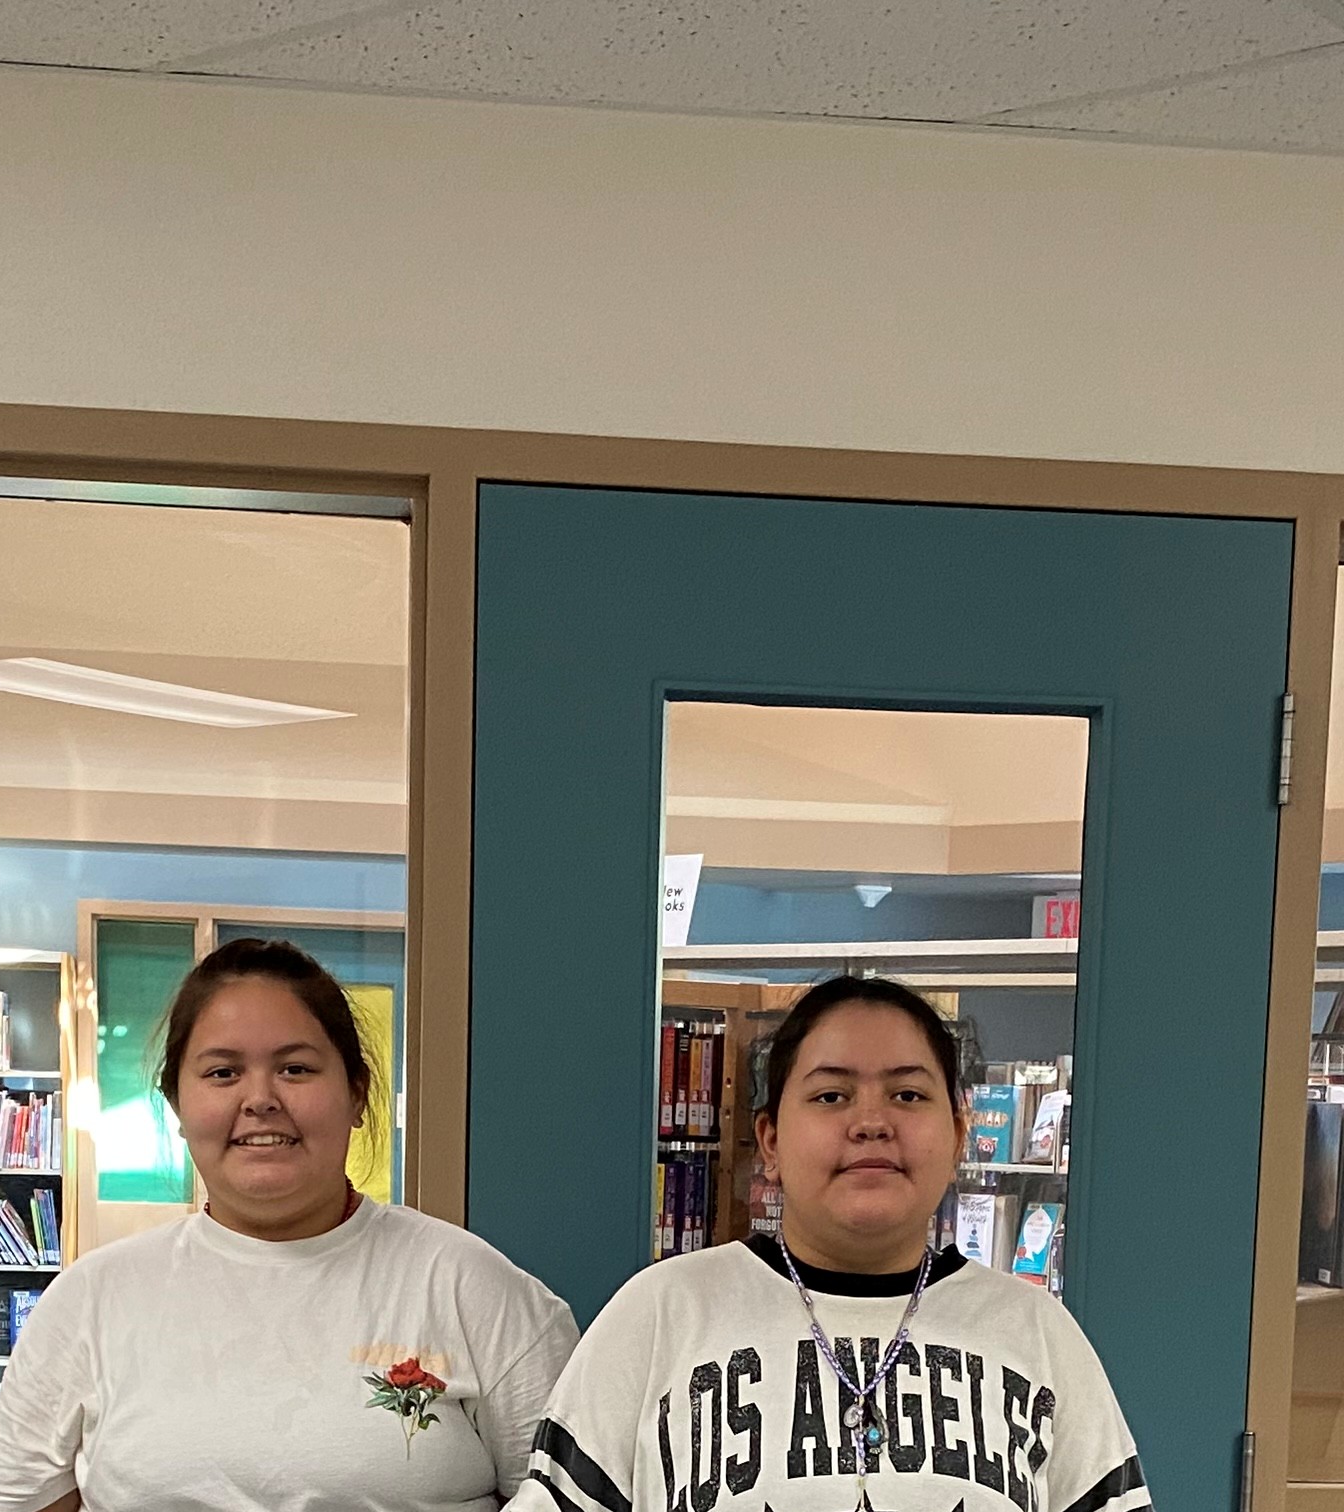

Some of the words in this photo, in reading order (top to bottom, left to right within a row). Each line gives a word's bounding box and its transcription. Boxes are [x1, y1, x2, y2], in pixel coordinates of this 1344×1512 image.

[665, 898, 685, 911] oks
[1045, 900, 1079, 938] EXI
[751, 1218, 782, 1231] FORGOT
